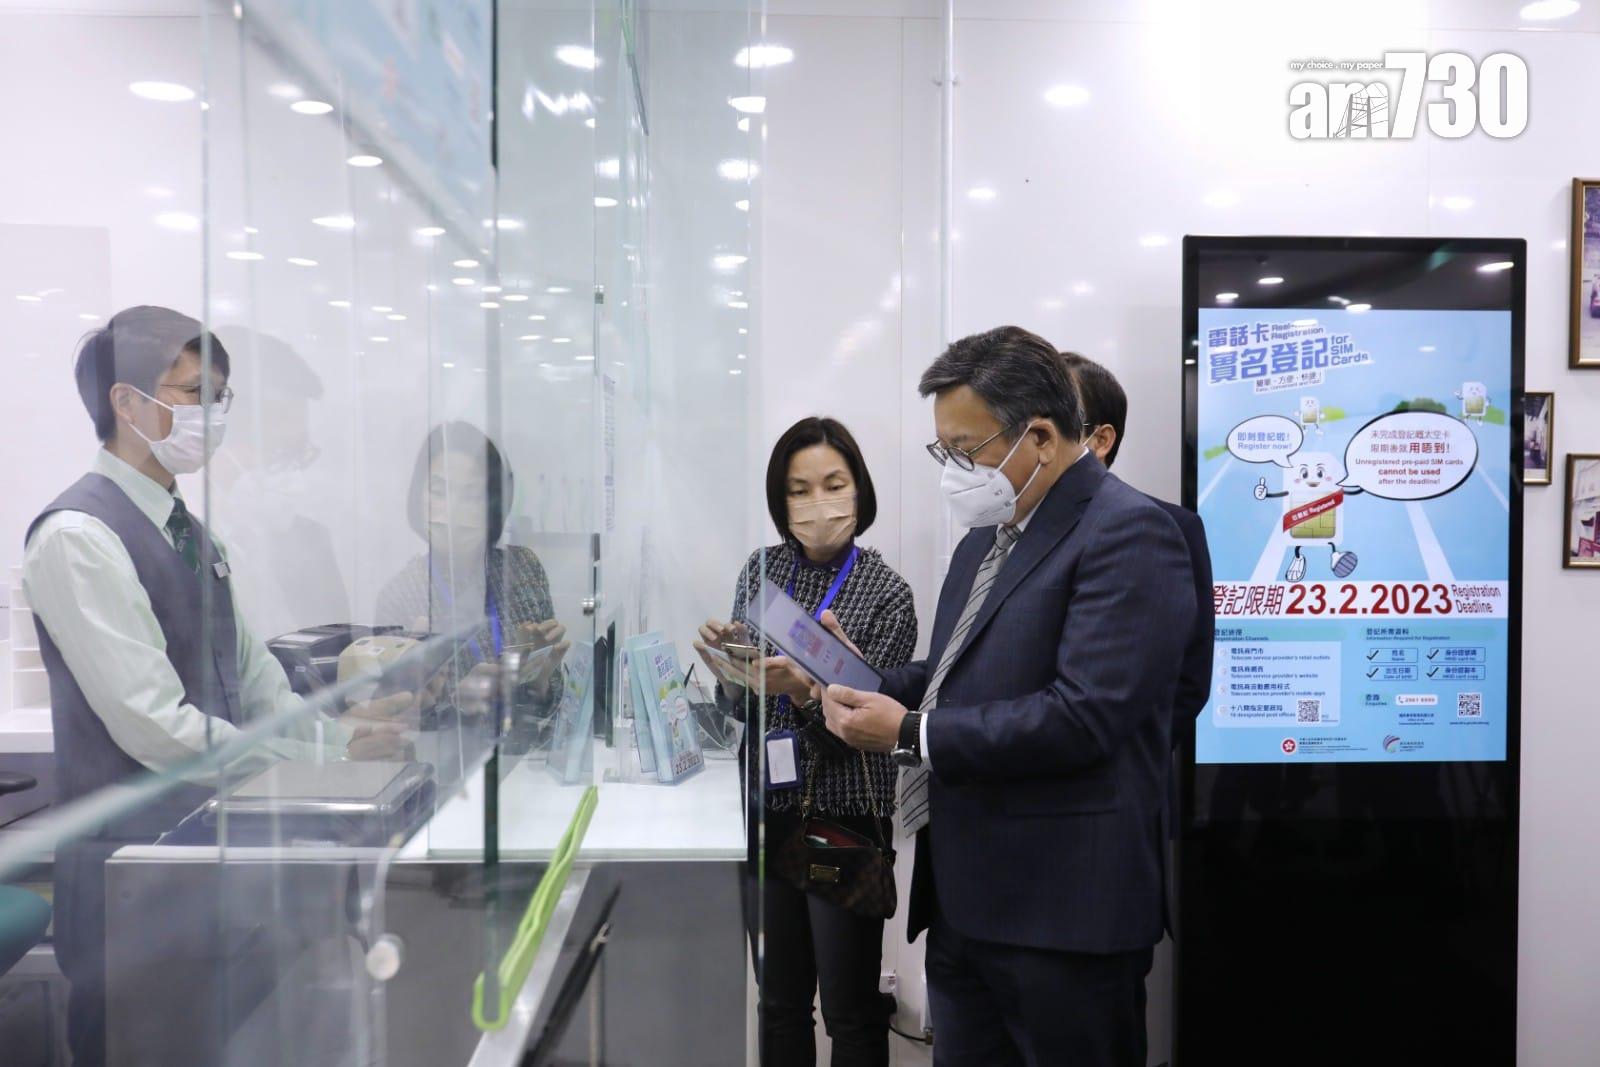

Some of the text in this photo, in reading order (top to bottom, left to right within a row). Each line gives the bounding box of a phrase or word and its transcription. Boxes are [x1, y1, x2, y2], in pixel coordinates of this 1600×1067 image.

[1208, 323, 1269, 348] 電話卡
[1331, 335, 1349, 346] for
[1331, 343, 1353, 355] SIM
[1210, 338, 1328, 383] 實名登記
[1331, 352, 1368, 366] Cards
[1238, 443, 1270, 451] Register
[1355, 458, 1400, 466] Unregistered
[1451, 584, 1501, 600] Registration
[1213, 584, 1453, 615] 登記限期 23.2.2023
[1456, 600, 1493, 613] Deadline
